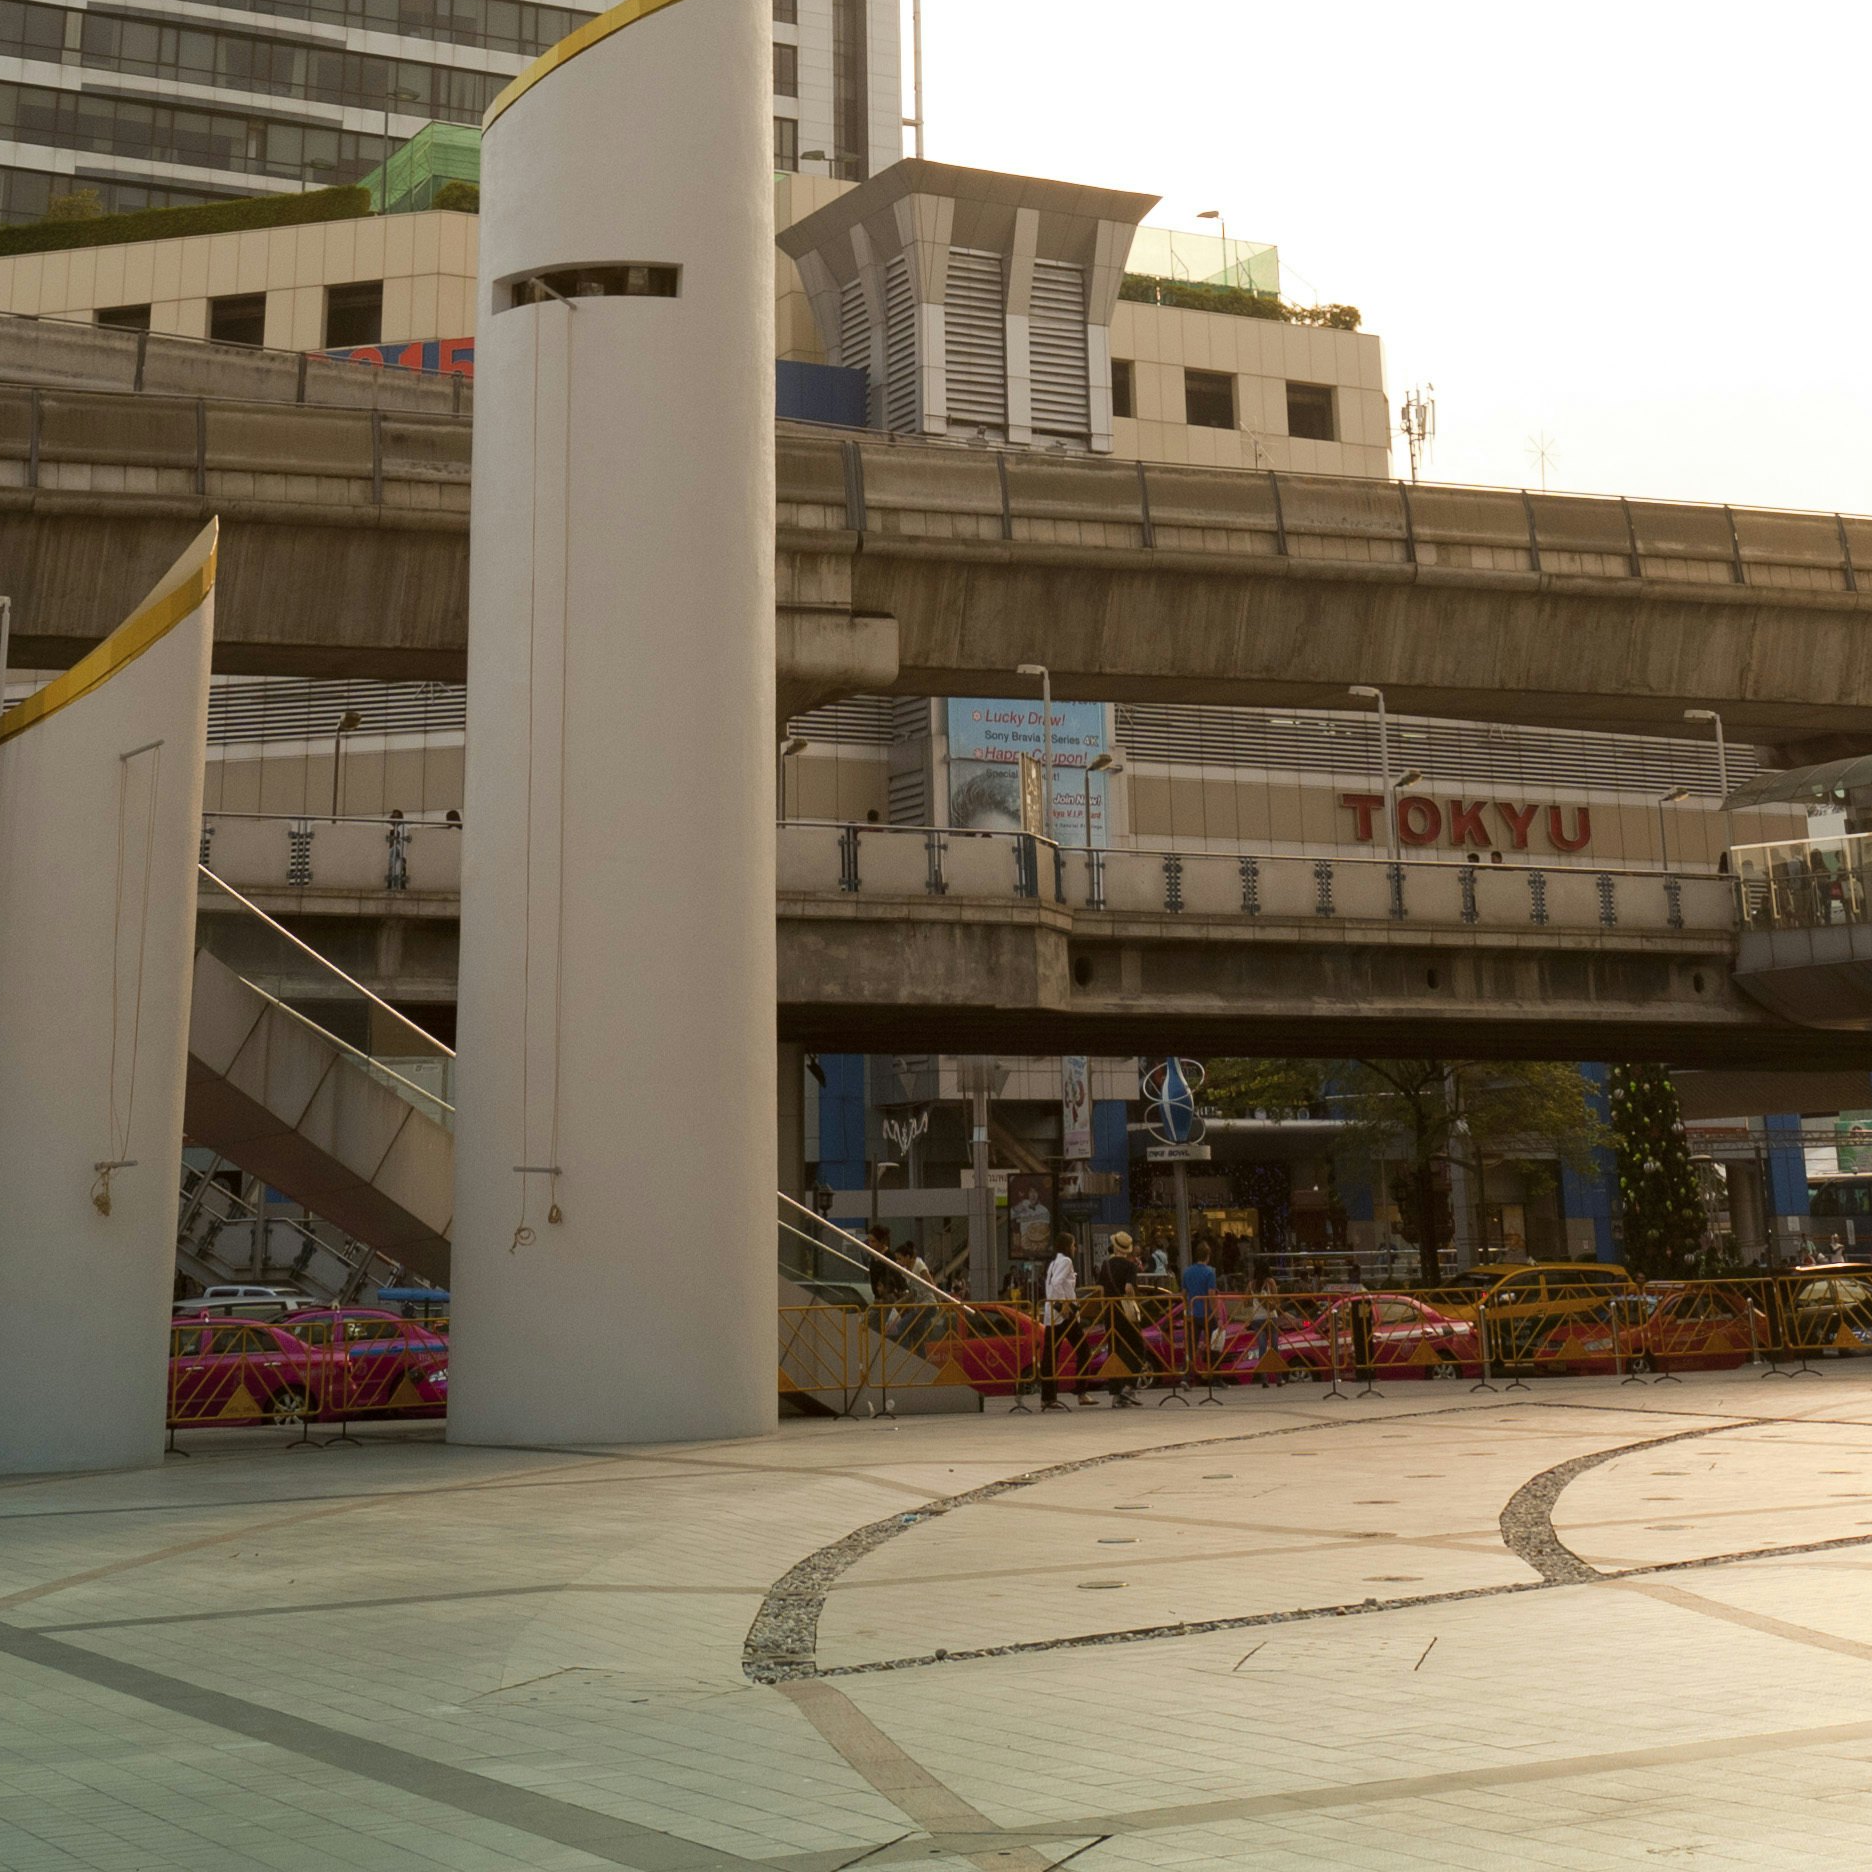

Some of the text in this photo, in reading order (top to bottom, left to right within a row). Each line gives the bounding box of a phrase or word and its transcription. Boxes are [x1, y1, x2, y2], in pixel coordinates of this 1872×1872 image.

[985, 708, 1066, 728] Lucky Drw!
[985, 730, 1009, 743] Sony
[1012, 732, 1040, 742] Bravia
[1051, 734, 1080, 745] Series
[1083, 735, 1099, 747] 4K
[1053, 792, 1101, 806] Join Nw!
[1340, 792, 1592, 853] TOKYU
